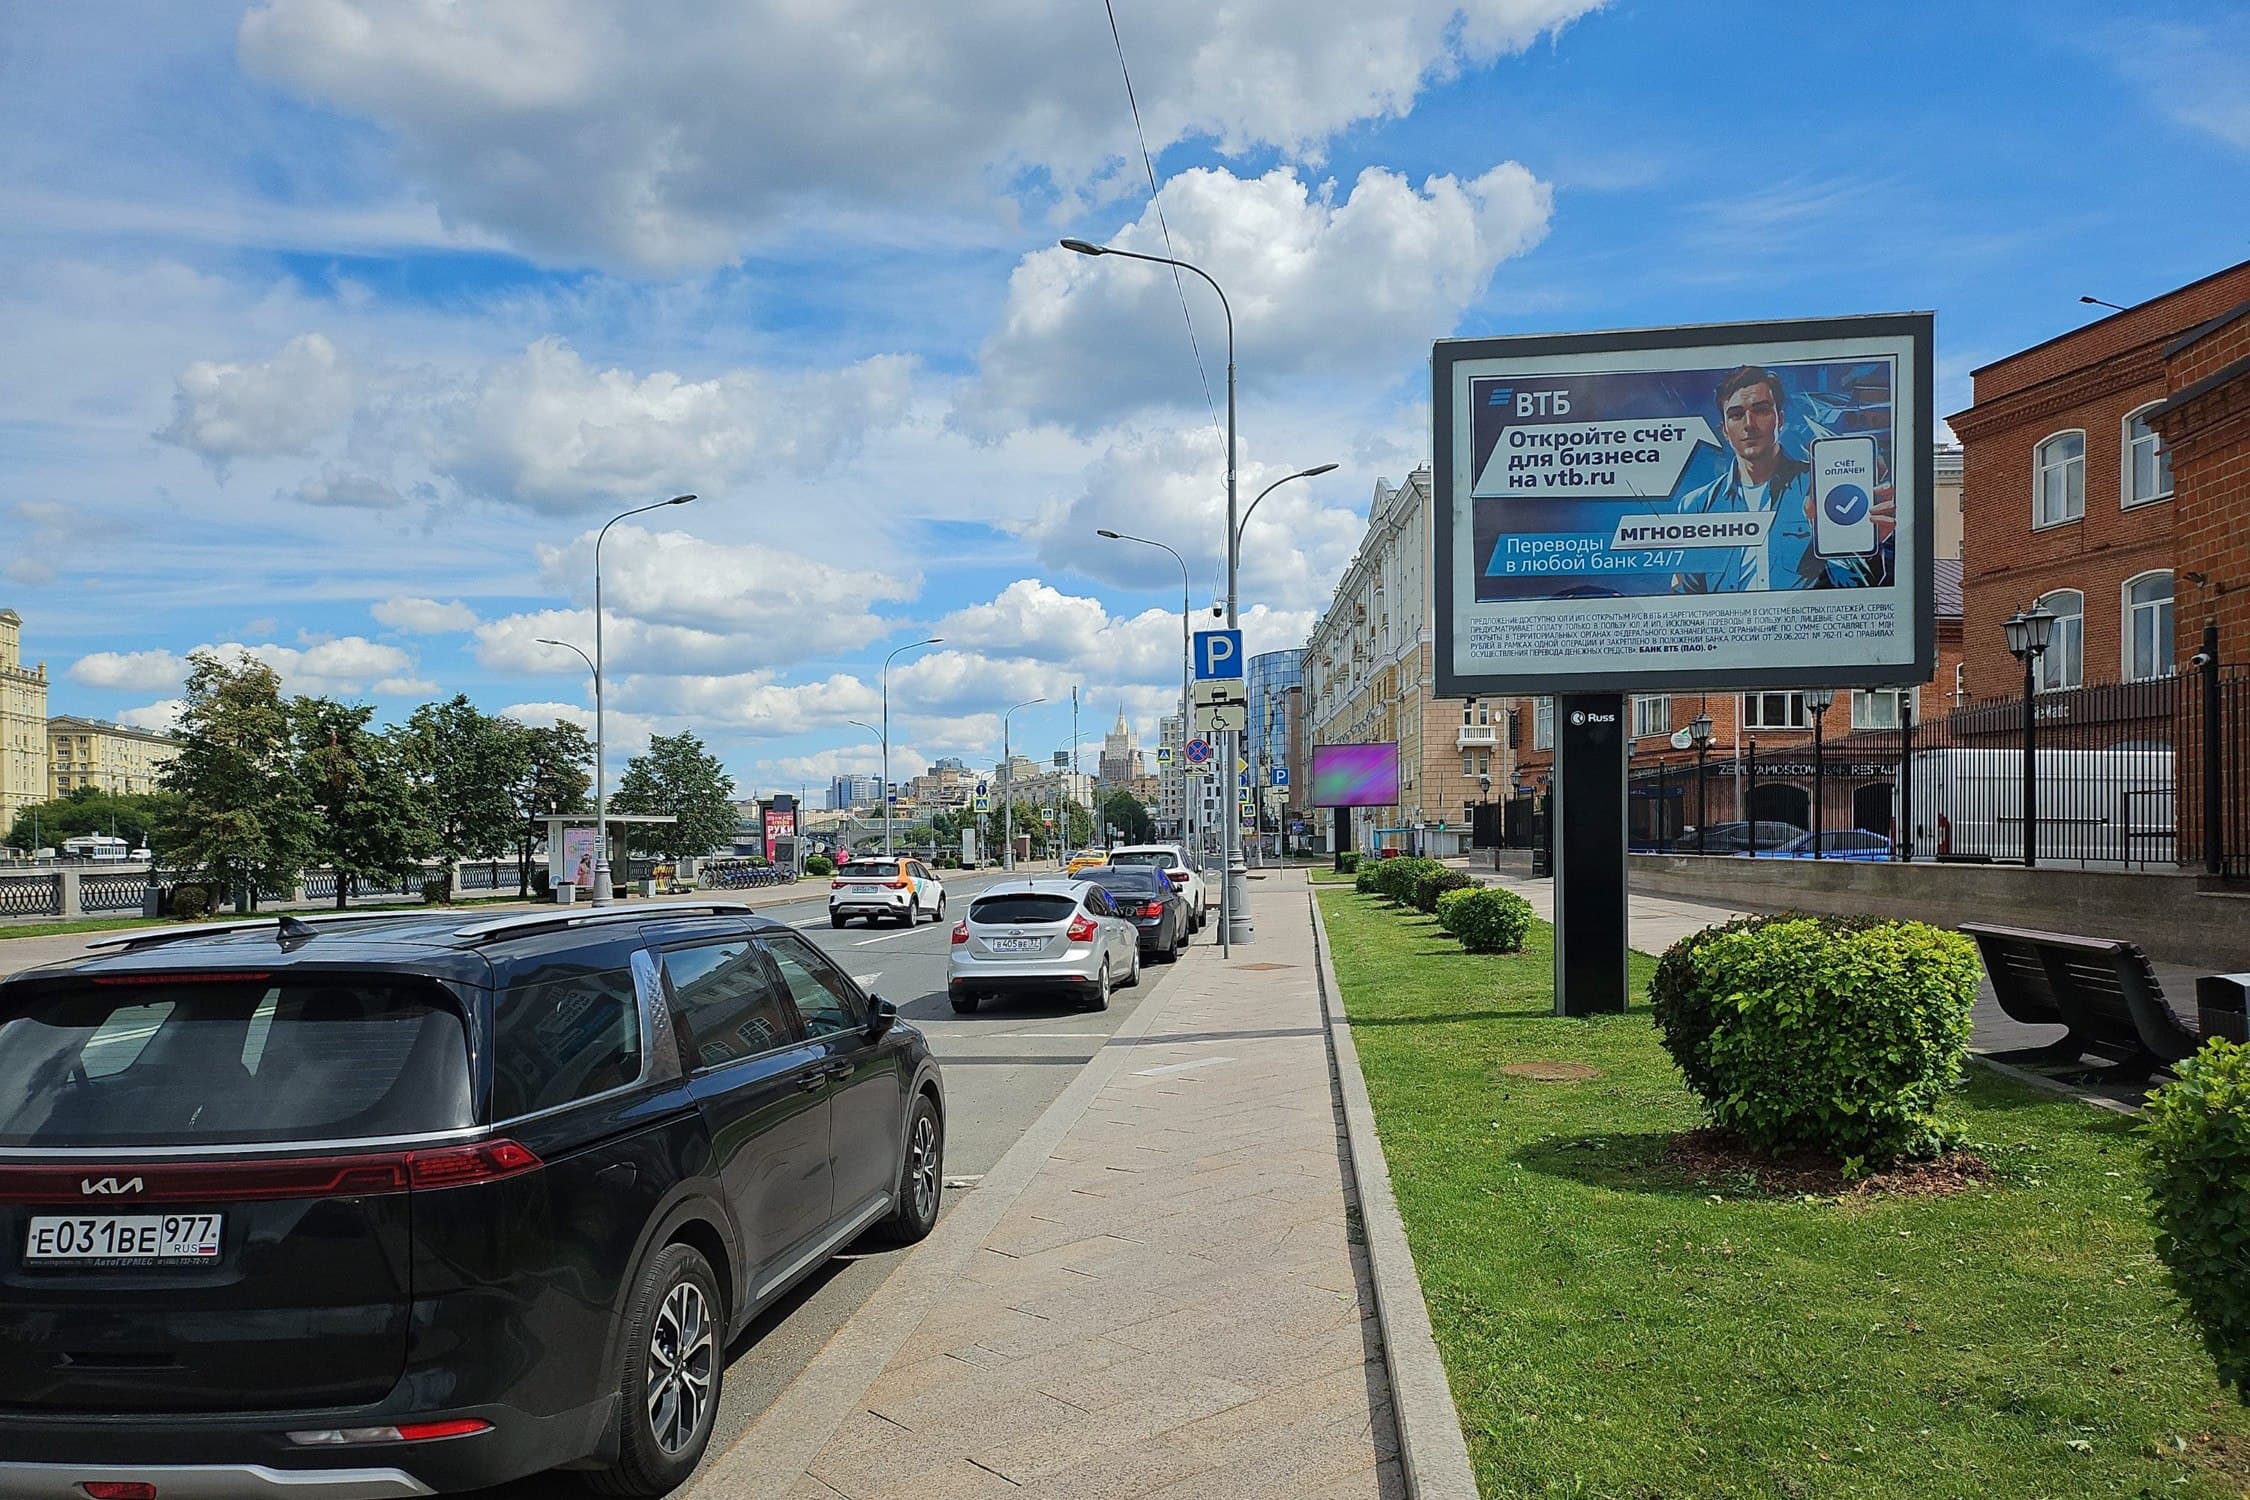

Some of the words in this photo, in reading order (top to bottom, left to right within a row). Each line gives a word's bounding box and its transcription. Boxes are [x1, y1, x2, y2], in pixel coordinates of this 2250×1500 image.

[1516, 390, 1571, 417] ВТБ
[1509, 427, 1627, 451] Откройте
[1633, 424, 1687, 442] счёт
[1508, 453, 1554, 471] для
[1560, 448, 1660, 466] бизнеса
[1834, 458, 1856, 467] СЧЁТ
[1509, 474, 1537, 488] на
[1543, 468, 1615, 488] vtb.ru
[1825, 466, 1865, 476] ОПЛАЧЕН
[1507, 538, 1604, 557] Переводы
[1620, 521, 1761, 542] мгновенно
[1506, 561, 1516, 572] в
[1520, 554, 1585, 572] любой
[1591, 553, 1637, 569] банк
[1643, 550, 1685, 568] 24/7
[1470, 617, 1519, 625] ПРЕДЛОЖЕНИЕ
[1519, 616, 1556, 624] ДОСТУПНО
[1592, 613, 1630, 621] ОТКРЫТЫМ
[1669, 608, 1751, 618] ЗАРЕГИСТРИРОВАННЫМ
[1758, 607, 1791, 615] СИСТЕМЕ
[1792, 606, 1826, 614] БЫСТРЫХ
[1867, 603, 1895, 612] СЕРВИС
[1470, 624, 1534, 633] ПРЕДУСМАТРИВАЕТ
[1565, 622, 1591, 630] ТОЛЬКО
[1601, 621, 1627, 629] ПОЛЬЗУ
[1666, 619, 1705, 627] ИСКЛЮЧАЯ
[1836, 613, 1858, 621] СЧЕТА
[1860, 612, 1895, 620] КОТОРЫХ
[1470, 633, 1503, 642] ОТКРЫТЫ
[1513, 631, 1578, 640] ТЕРРИТОРИАЛЬНЫХ
[1580, 630, 1611, 638] ОРГАНАХ
[1614, 628, 1667, 638] ФЕДЕРАЛЬНОГО
[1794, 623, 1820, 631] СУММЕ
[1822, 621, 1867, 630] СОСТАВЛЯЕТ
[1470, 641, 1495, 650] РУБЛЕЙ
[1534, 639, 1559, 648] ОДНОЙ
[1561, 639, 1597, 647] ОПЕРАЦИИ
[1705, 635, 1729, 643] БАНКА
[1856, 629, 1895, 638] ПРАВИЛАХ
[1207, 636, 1234, 675] P
[1470, 649, 1529, 658] ОСУЩЕСТВЛЕНИЯ
[1529, 648, 1563, 656] ПЕРЕВОДА
[1564, 647, 1601, 655] ДЕНЕЖНЫХ
[1639, 645, 1661, 653] БАНК
[1680, 644, 1706, 653] (ПАО).
[1707, 644, 1718, 652] 0+
[1587, 712, 1615, 723] Russ
[1276, 770, 1286, 784] P
[767, 825, 794, 834] РУКИ
[81, 1176, 144, 1195] KIA
[165, 1216, 213, 1243] 977
[174, 1243, 198, 1253] RUS
